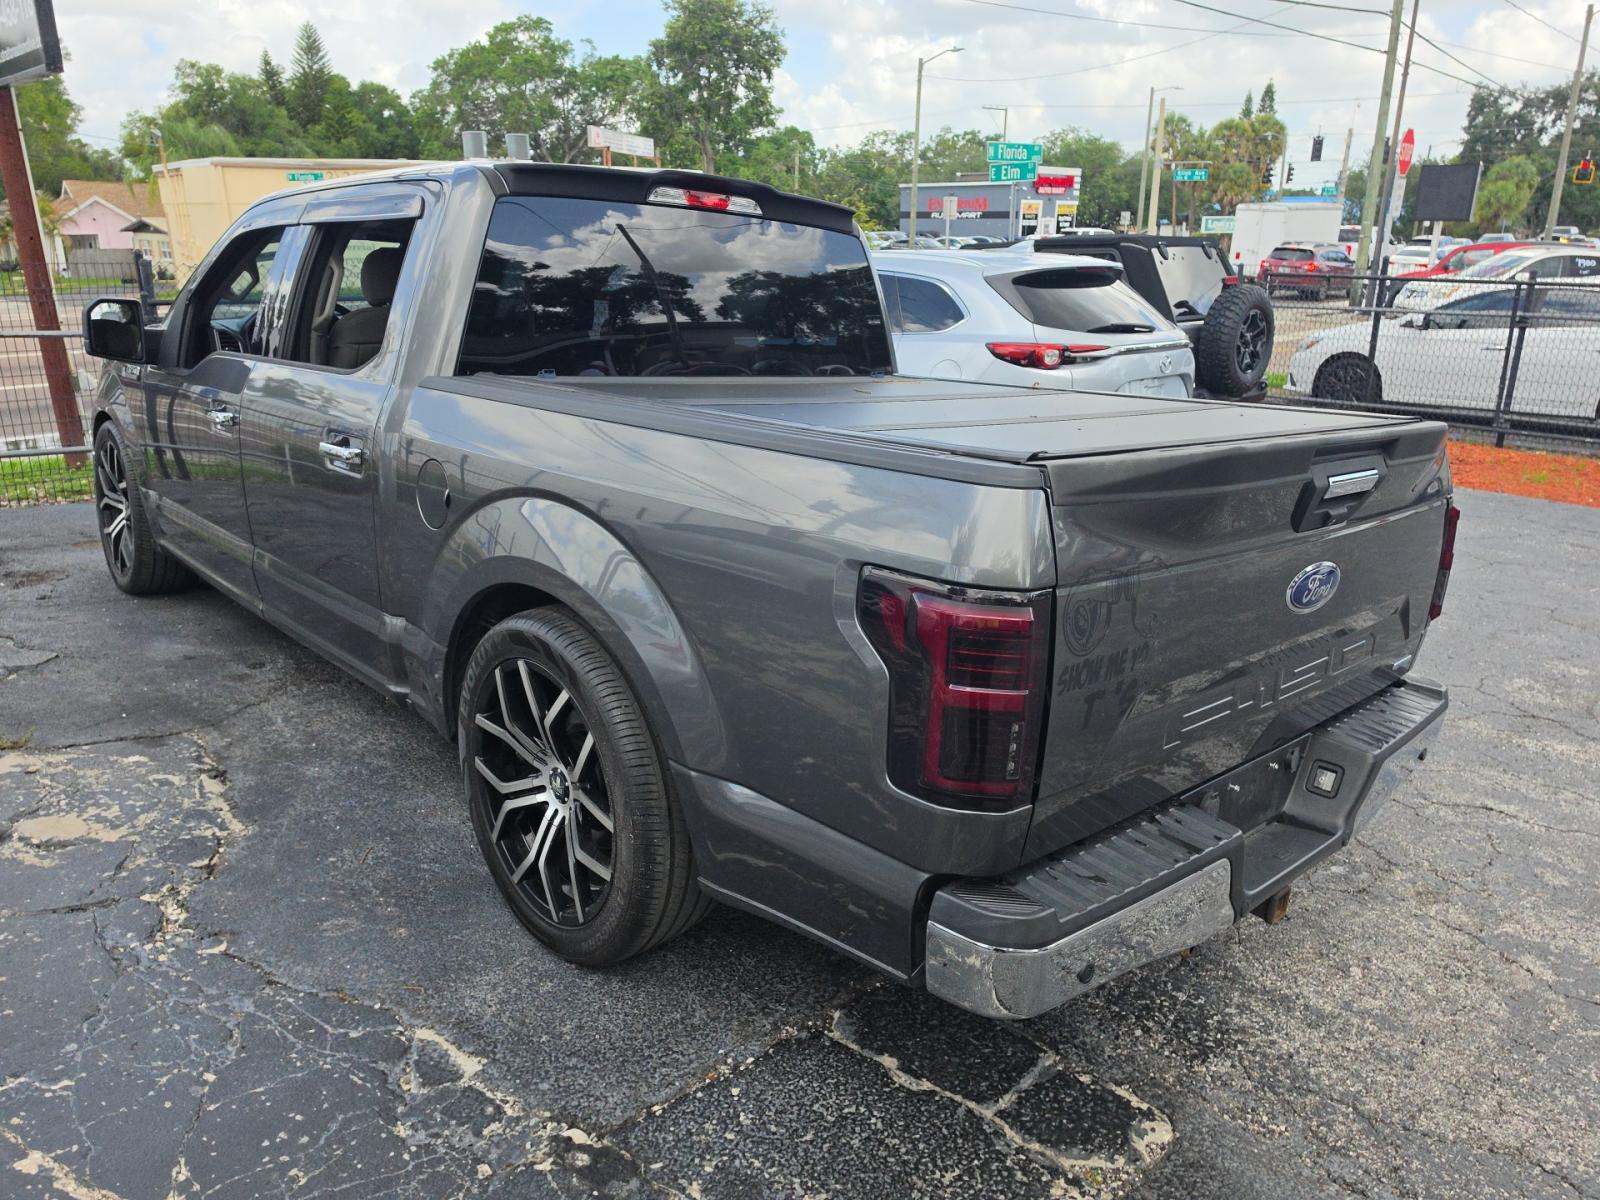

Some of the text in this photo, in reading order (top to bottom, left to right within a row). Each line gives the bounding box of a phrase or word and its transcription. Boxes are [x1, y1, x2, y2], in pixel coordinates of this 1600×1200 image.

[998, 144, 1027, 160] Florida
[1399, 142, 1414, 161] STOP
[991, 167, 996, 179] E
[1001, 165, 1020, 179] Elm
[1302, 574, 1334, 604] Ford
